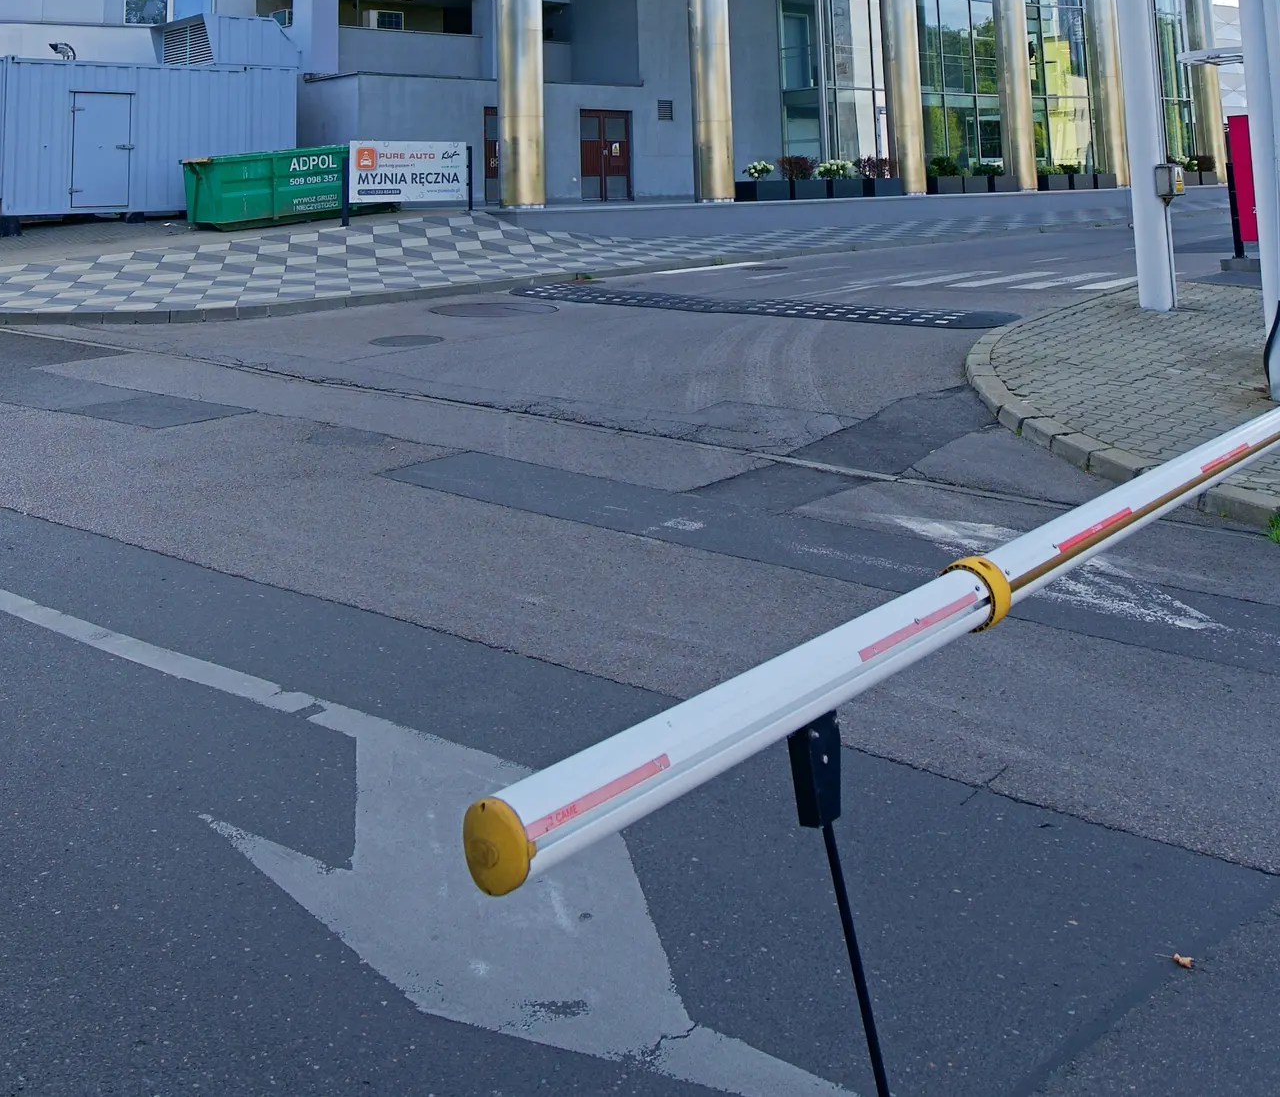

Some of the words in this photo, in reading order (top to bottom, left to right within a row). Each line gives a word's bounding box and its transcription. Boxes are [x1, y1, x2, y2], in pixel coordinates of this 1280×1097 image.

[378, 152, 406, 160] PURE
[409, 152, 436, 160] AUTO
[289, 154, 337, 172] ADPOL
[289, 178, 304, 186] 509
[306, 176, 321, 184] 098
[323, 174, 338, 182] 357
[357, 172, 407, 185] MYJNIA
[411, 172, 460, 186] RĘCZNA
